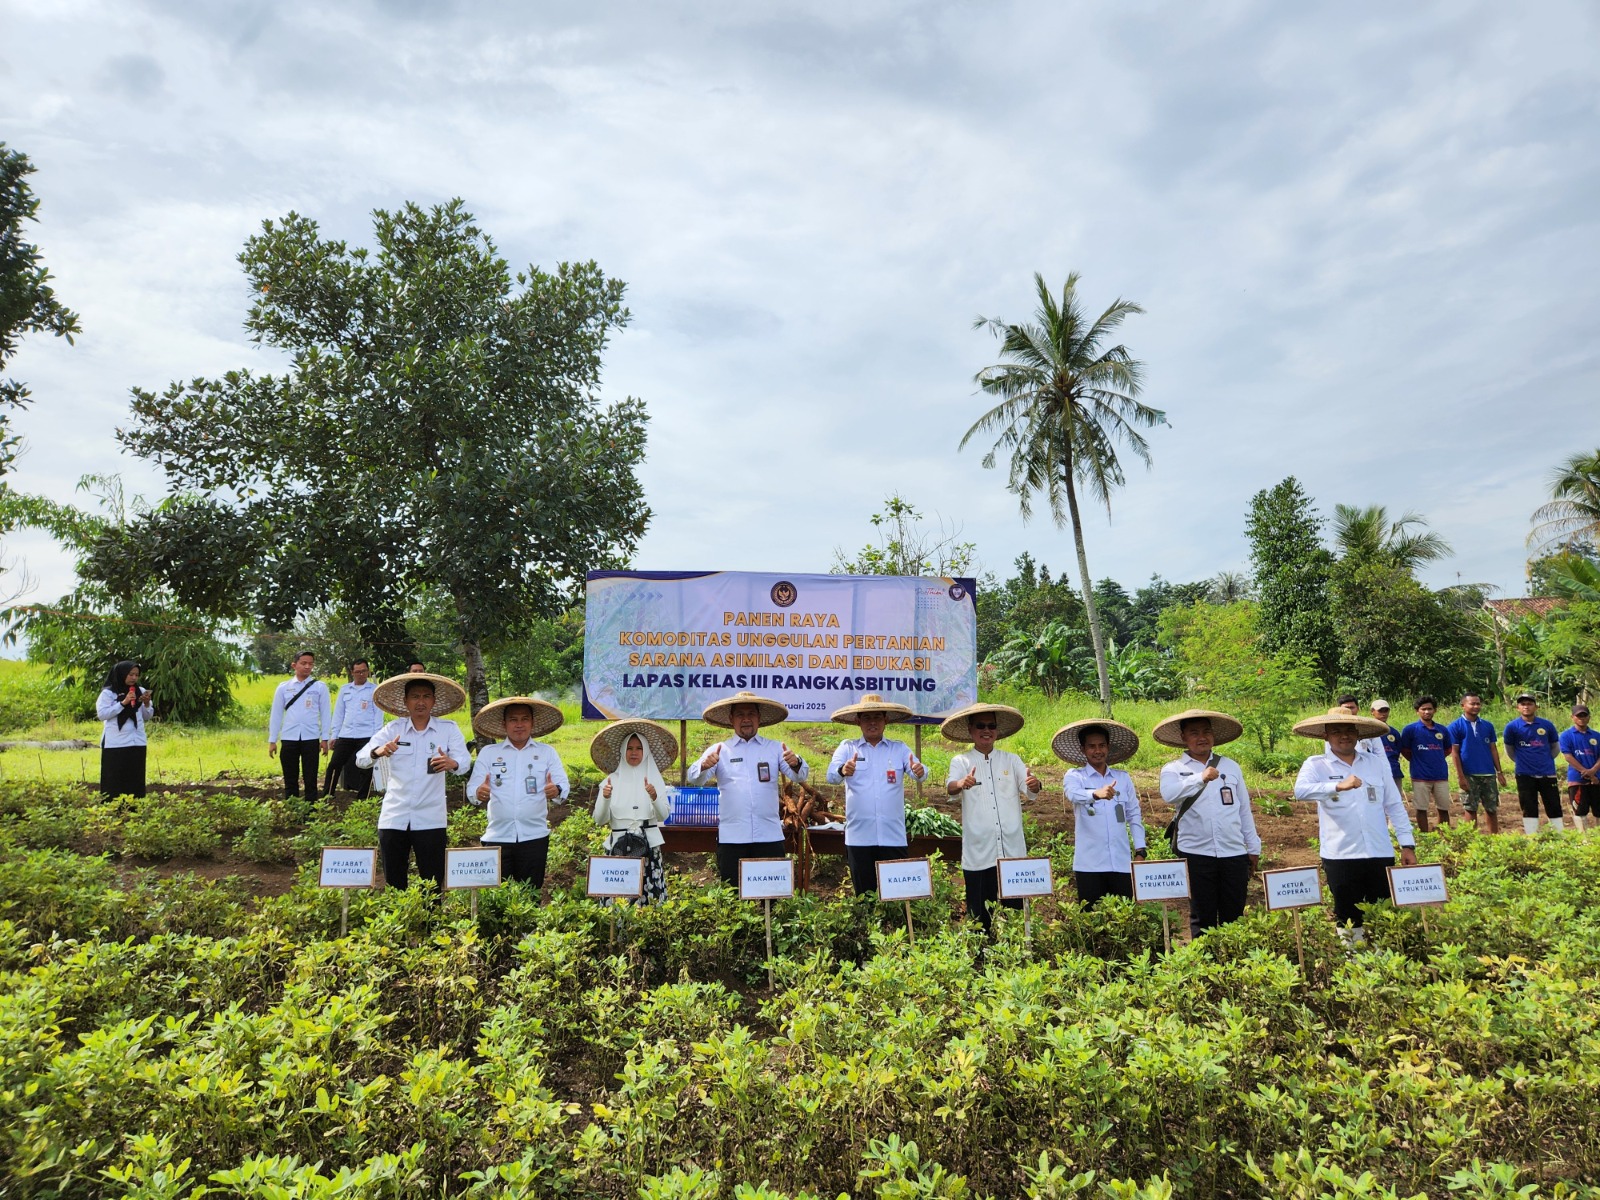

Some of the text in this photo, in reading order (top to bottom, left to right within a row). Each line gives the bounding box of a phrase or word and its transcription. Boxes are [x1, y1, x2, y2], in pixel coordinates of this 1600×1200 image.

[723, 611, 840, 628] PANEN RAYA
[619, 631, 945, 651] KOMODITAS UNGGULAN PERTANIAN
[629, 652, 931, 671] SARANA ASIMILASI DAN EDUKASI
[622, 673, 936, 692] LAPAS KELAS III RANGKASBITUNG
[784, 702, 827, 710] ruari 2025
[887, 875, 922, 884] KALAPAS
[1145, 873, 1177, 881] PEJABAT
[1281, 881, 1304, 889] KETUA
[1397, 885, 1442, 893] STRUKTURAL
[1276, 888, 1312, 896] KOPERASI
